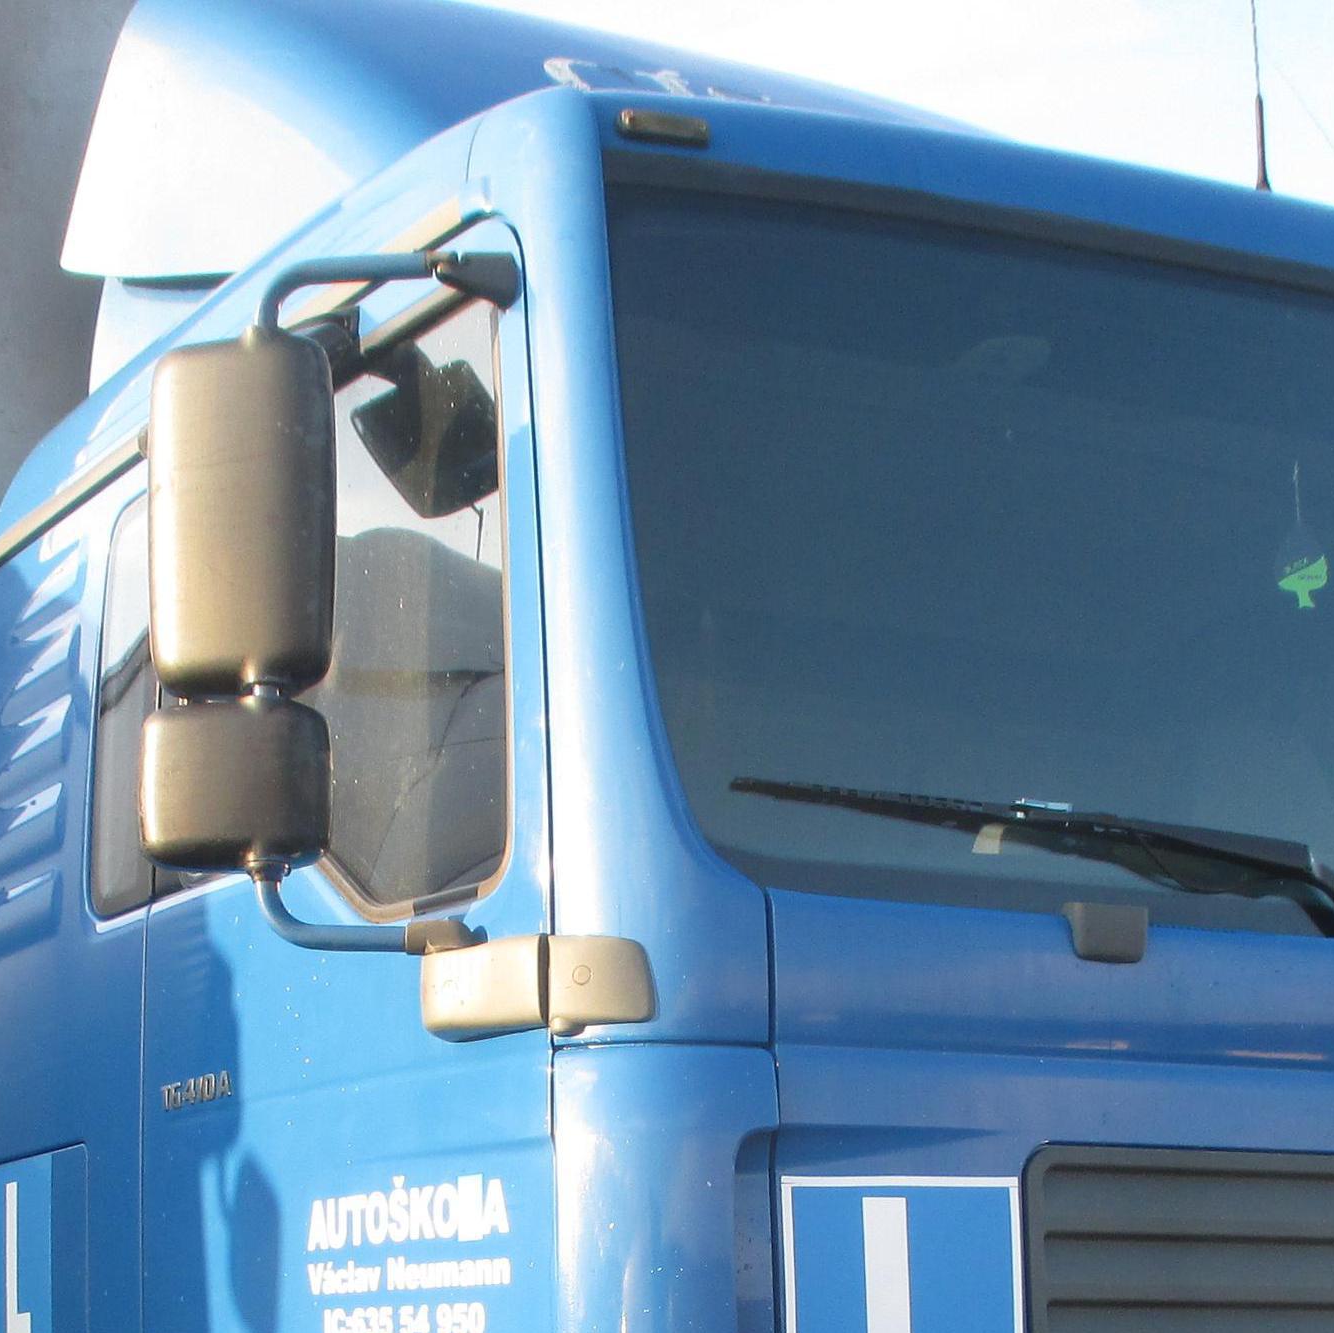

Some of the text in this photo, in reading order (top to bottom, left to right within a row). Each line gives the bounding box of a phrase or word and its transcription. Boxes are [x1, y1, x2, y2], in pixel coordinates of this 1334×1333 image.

[307, 1173, 509, 1251] AUTOŠKOA
[307, 1256, 511, 1295] Václav Neumann
